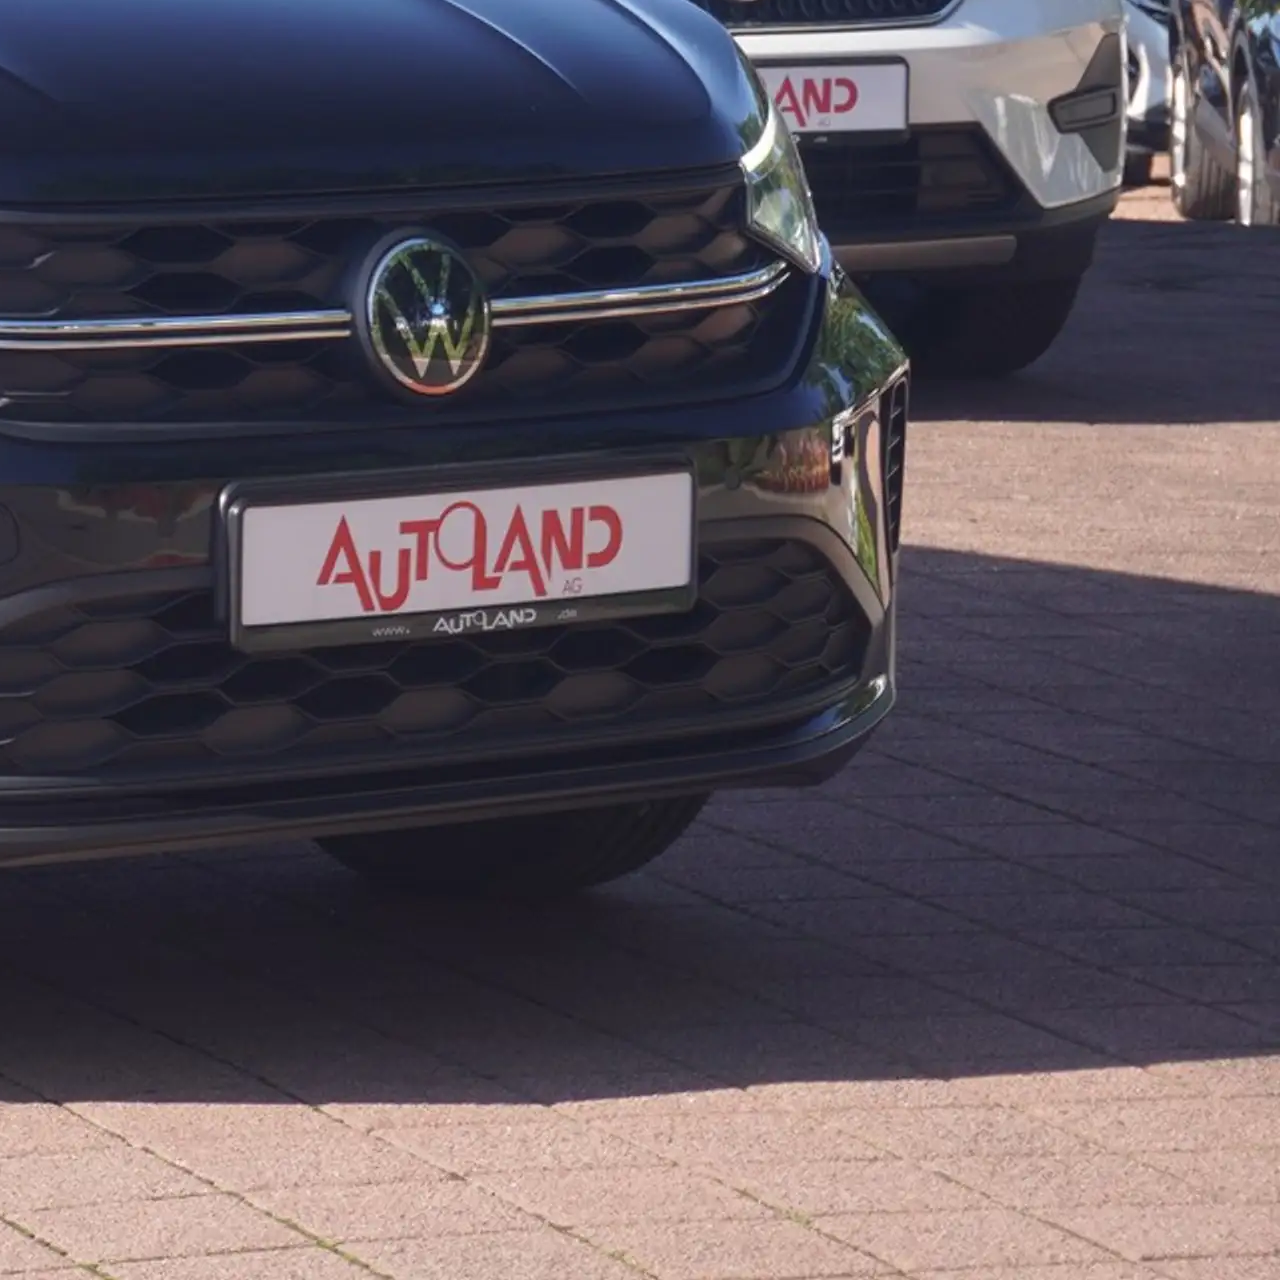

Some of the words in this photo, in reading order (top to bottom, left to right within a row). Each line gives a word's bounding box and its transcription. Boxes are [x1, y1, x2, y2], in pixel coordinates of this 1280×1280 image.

[316, 500, 623, 612] AUTOLAND
[562, 577, 583, 595] AG
[432, 608, 538, 635] AUTOLAND
